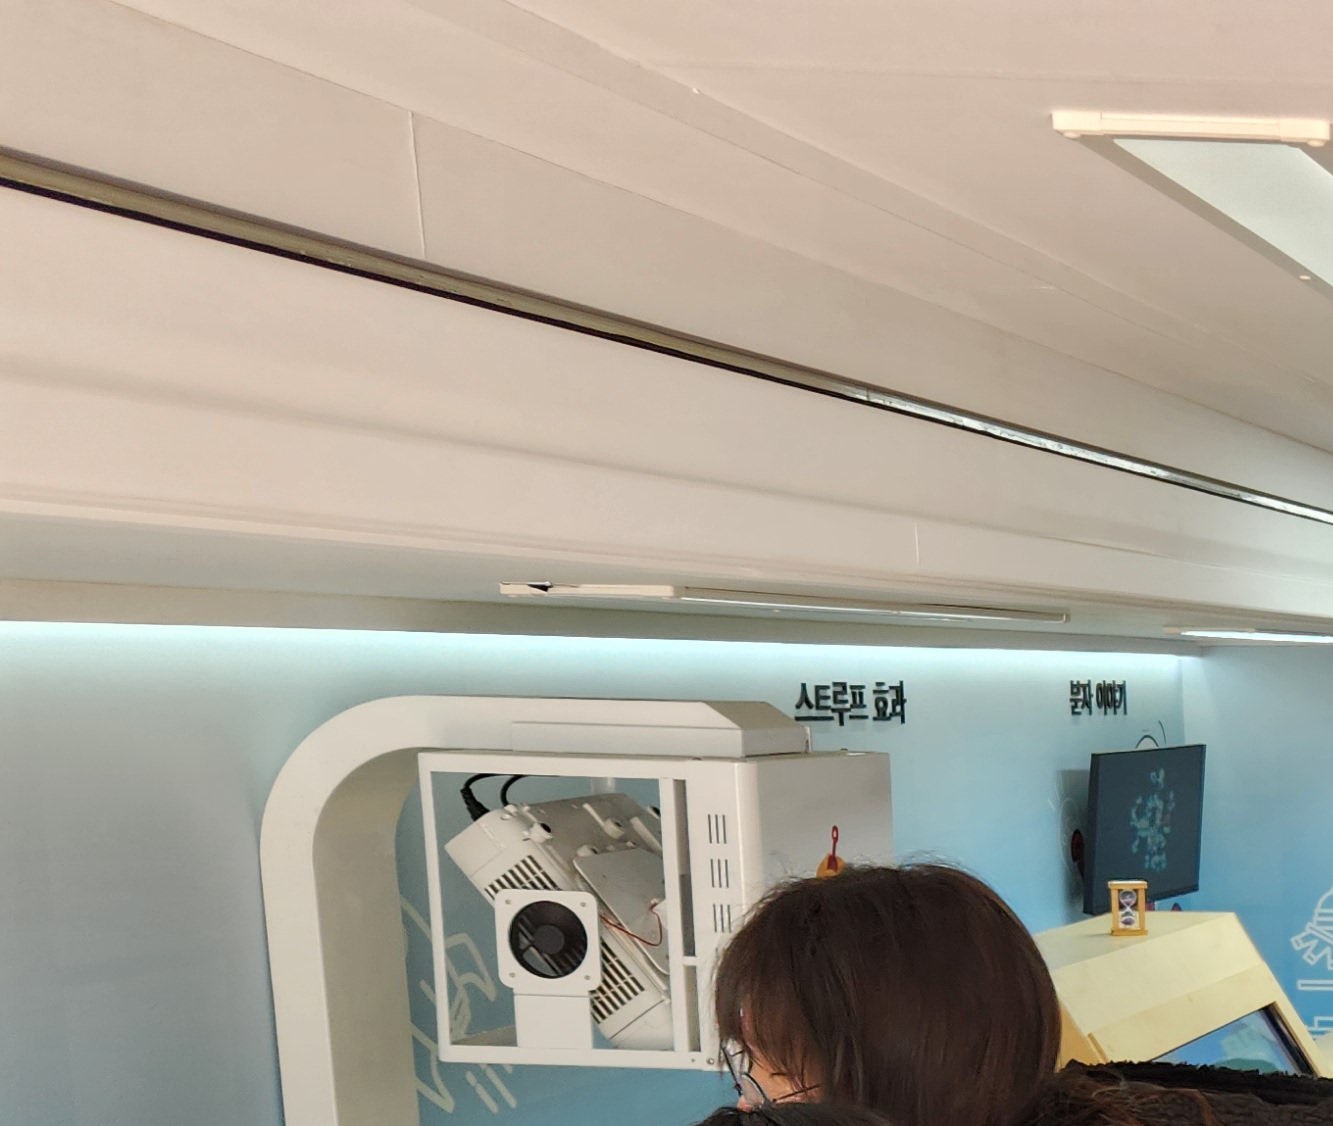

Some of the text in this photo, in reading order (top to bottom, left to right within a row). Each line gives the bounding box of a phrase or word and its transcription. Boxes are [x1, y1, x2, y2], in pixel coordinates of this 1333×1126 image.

[794, 680, 907, 727] 스트루프 효과
[1069, 679, 1128, 716] 분자 이야기
